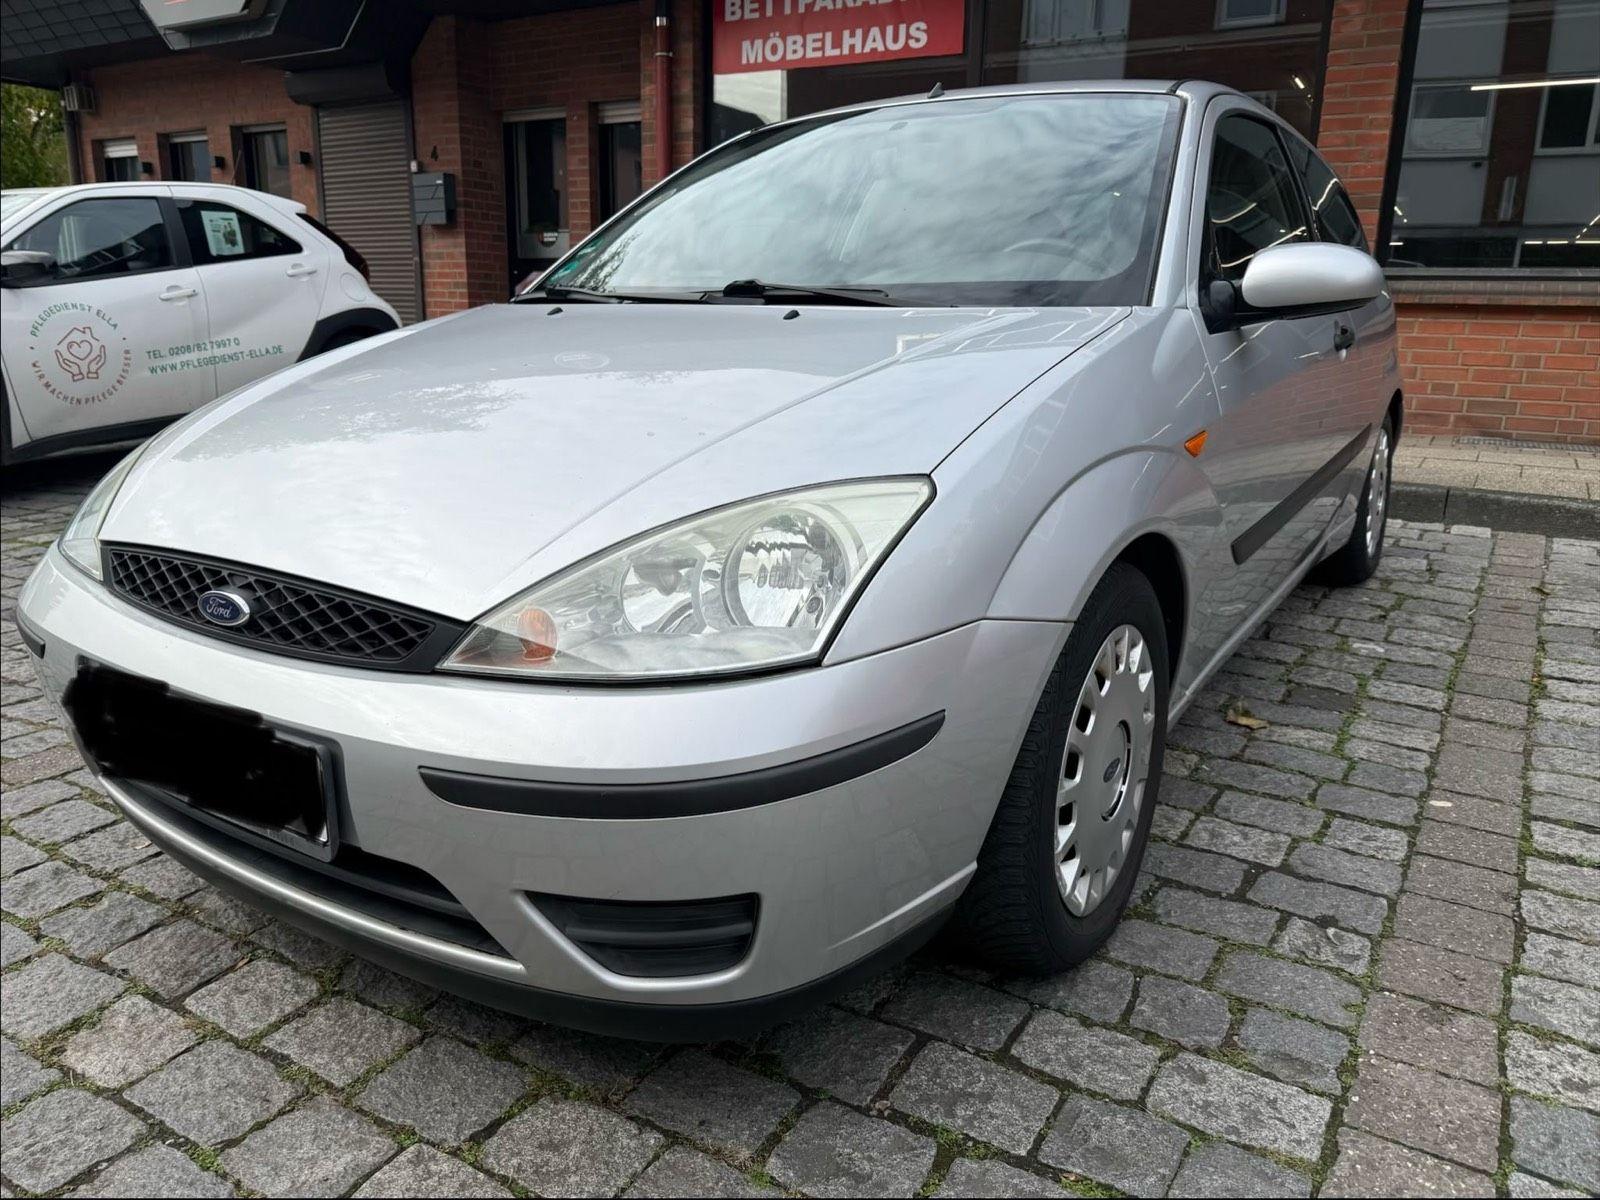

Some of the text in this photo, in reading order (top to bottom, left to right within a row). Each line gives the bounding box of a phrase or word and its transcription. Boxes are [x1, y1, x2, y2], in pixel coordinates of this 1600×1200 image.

[741, 22, 928, 64] MÖBELHAUS
[30, 302, 118, 337] PFLEGEDIENST ELLA
[145, 349, 166, 360] TEL.
[148, 344, 284, 375] WWW.PFLEGEDIENST-ELLA.DE
[43, 381, 82, 405] MACHEN
[84, 384, 118, 405] PFLEGE
[206, 596, 233, 619] Ford
